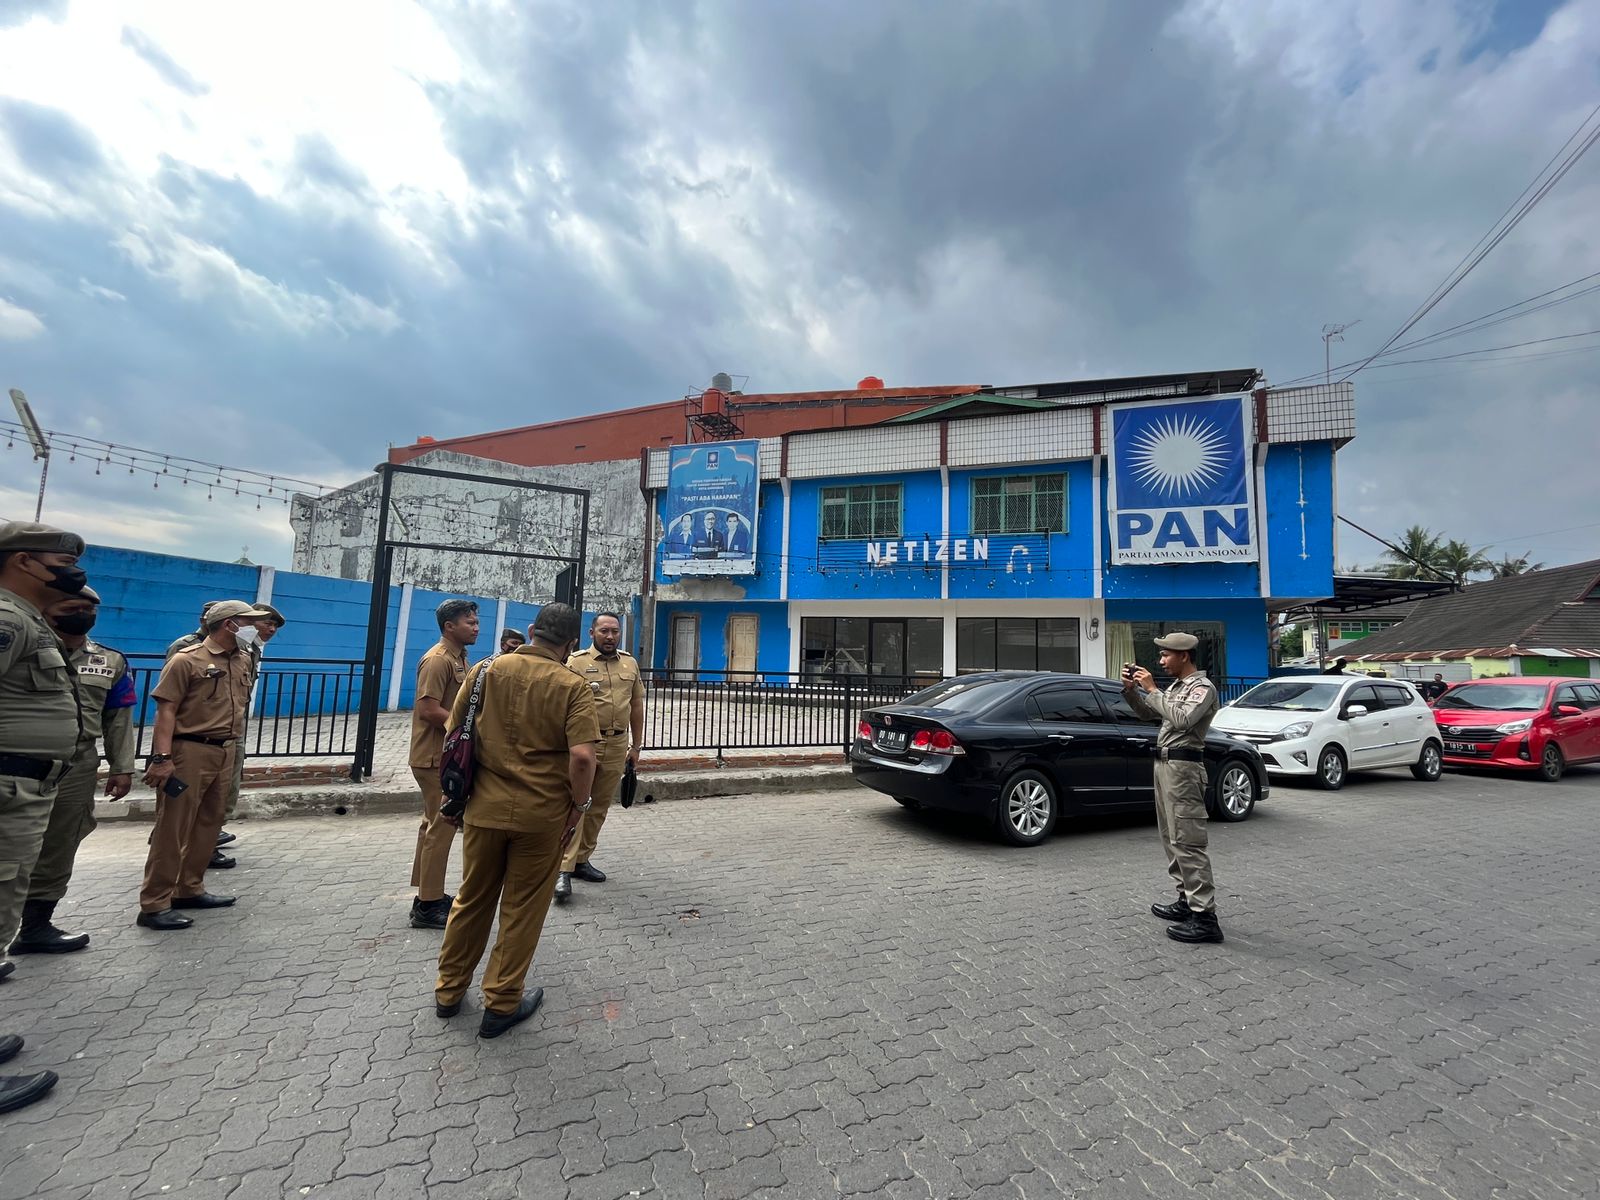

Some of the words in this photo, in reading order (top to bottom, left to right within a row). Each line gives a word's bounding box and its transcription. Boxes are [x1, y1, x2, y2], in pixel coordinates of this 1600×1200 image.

[1117, 507, 1250, 550] PAN
[867, 539, 988, 563] NETIZEN
[1119, 551, 1151, 559] PARTAI
[1152, 550, 1195, 558] AMANAT
[1198, 549, 1251, 557] NASIONAL
